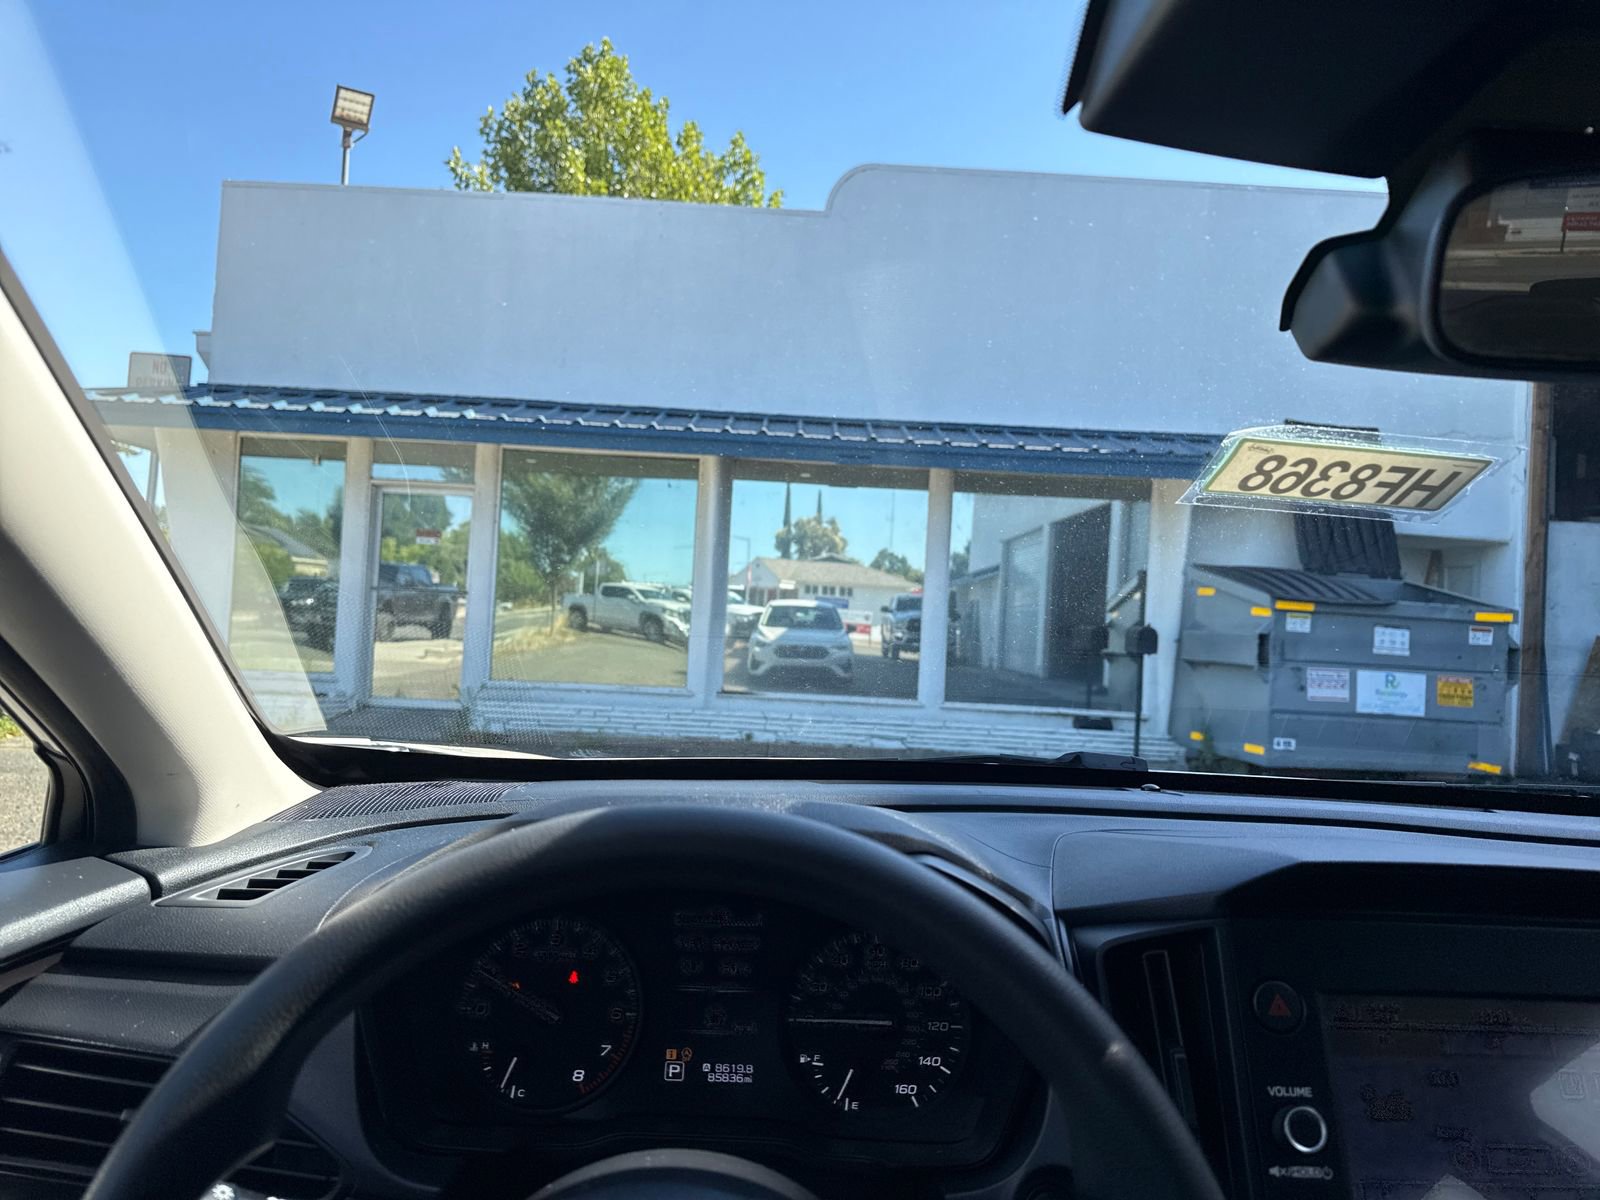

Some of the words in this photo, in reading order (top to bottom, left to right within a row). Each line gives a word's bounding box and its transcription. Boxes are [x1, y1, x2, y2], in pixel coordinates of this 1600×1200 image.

[152, 359, 167, 374] NO
[928, 1022, 949, 1031] 120
[600, 1045, 612, 1056] 7
[813, 1054, 821, 1062] F
[918, 1056, 941, 1067] 140
[669, 1064, 681, 1078] P
[714, 1063, 754, 1073] 8619.8
[571, 1070, 586, 1082] 8
[518, 1088, 526, 1097] C
[895, 1084, 917, 1095] 160
[1267, 1086, 1313, 1098] VOLUME
